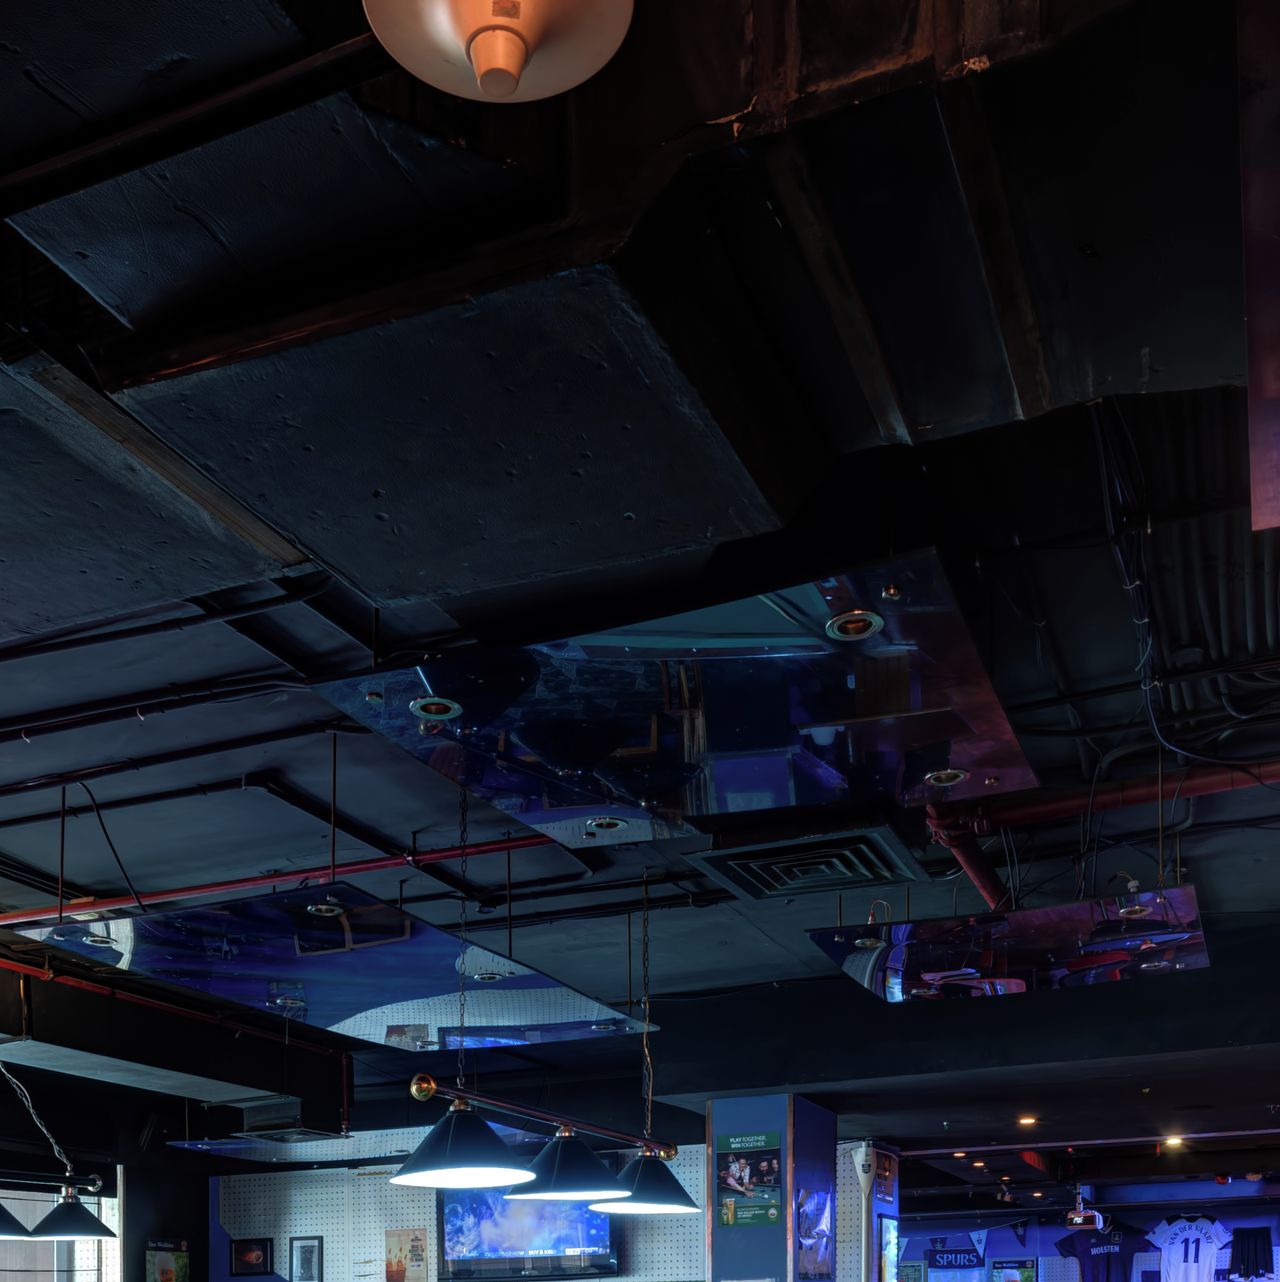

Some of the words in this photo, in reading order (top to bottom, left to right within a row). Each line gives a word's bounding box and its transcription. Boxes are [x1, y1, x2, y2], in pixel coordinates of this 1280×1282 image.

[1179, 1225, 1193, 1233] DER
[1090, 1245, 1120, 1256] HOLSTEN
[1180, 1237, 1200, 1264] 11
[936, 1253, 977, 1266] SPURS
